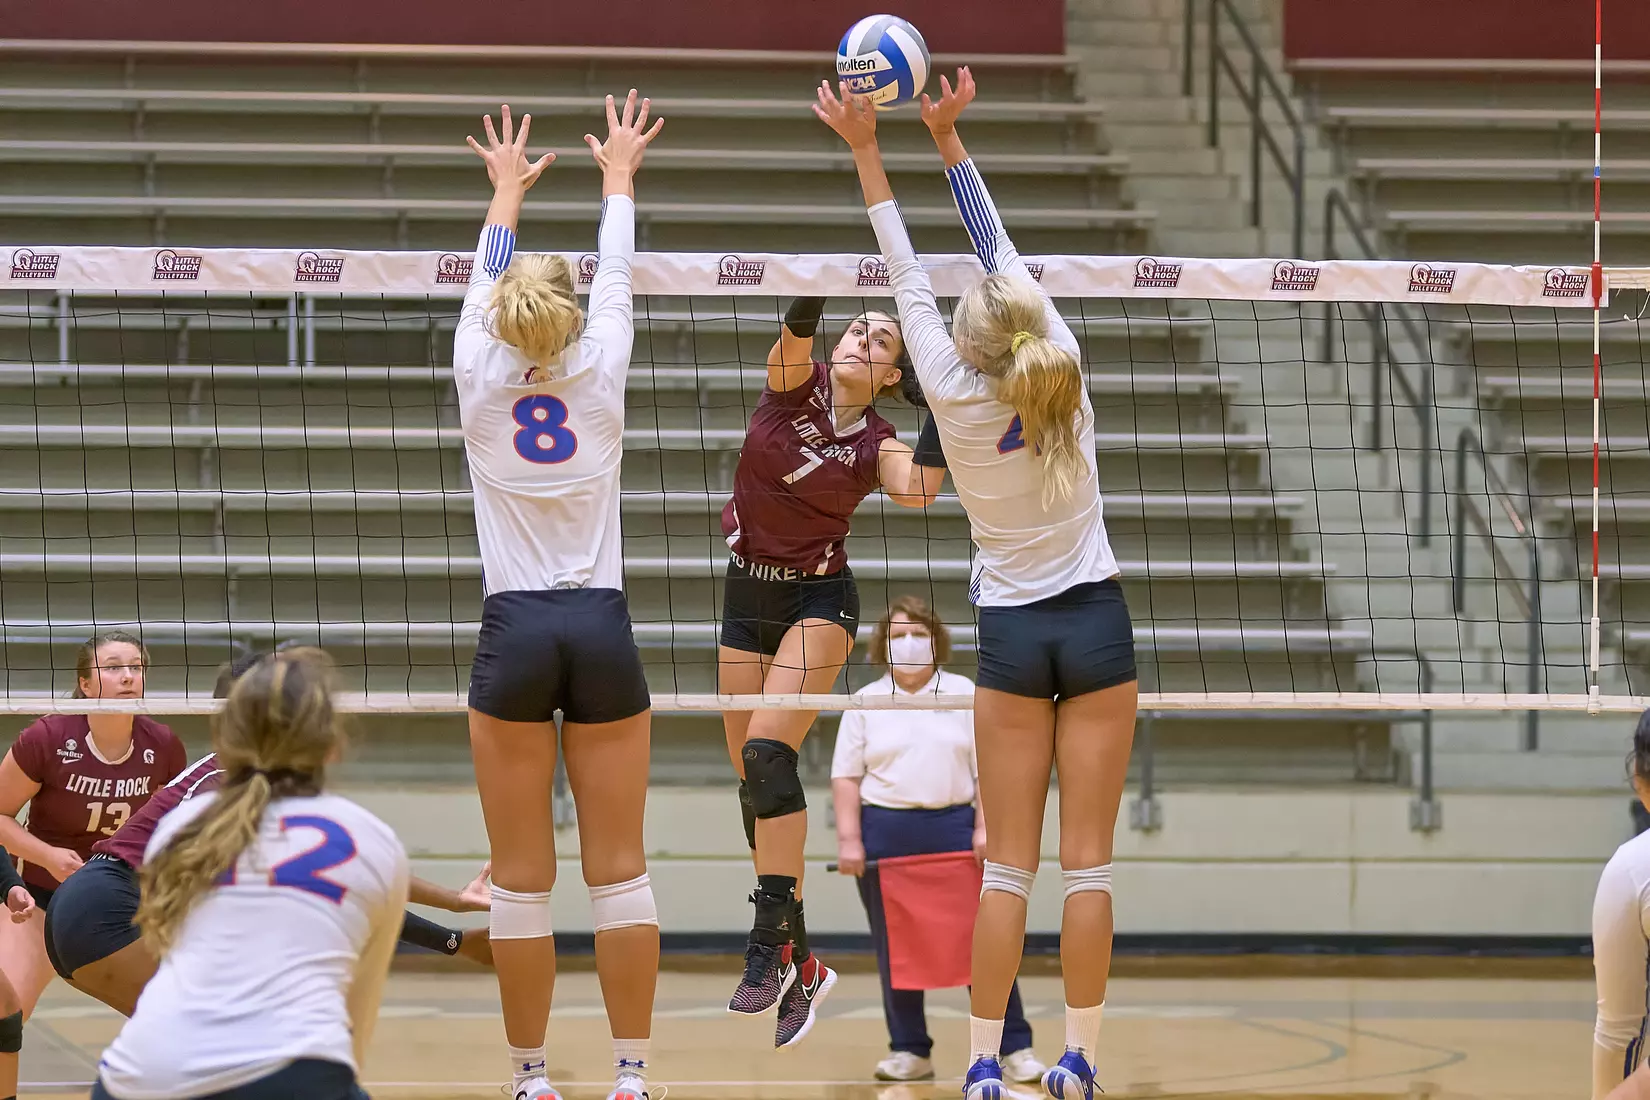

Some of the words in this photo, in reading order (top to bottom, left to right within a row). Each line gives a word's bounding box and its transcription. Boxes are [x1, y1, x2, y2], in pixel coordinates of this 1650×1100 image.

[512, 394, 578, 465] 8
[781, 446, 824, 485] 7
[749, 562, 797, 582] NIKE
[65, 773, 112, 798] LITTLE
[114, 776, 151, 798] ROCK
[86, 802, 131, 836] 13
